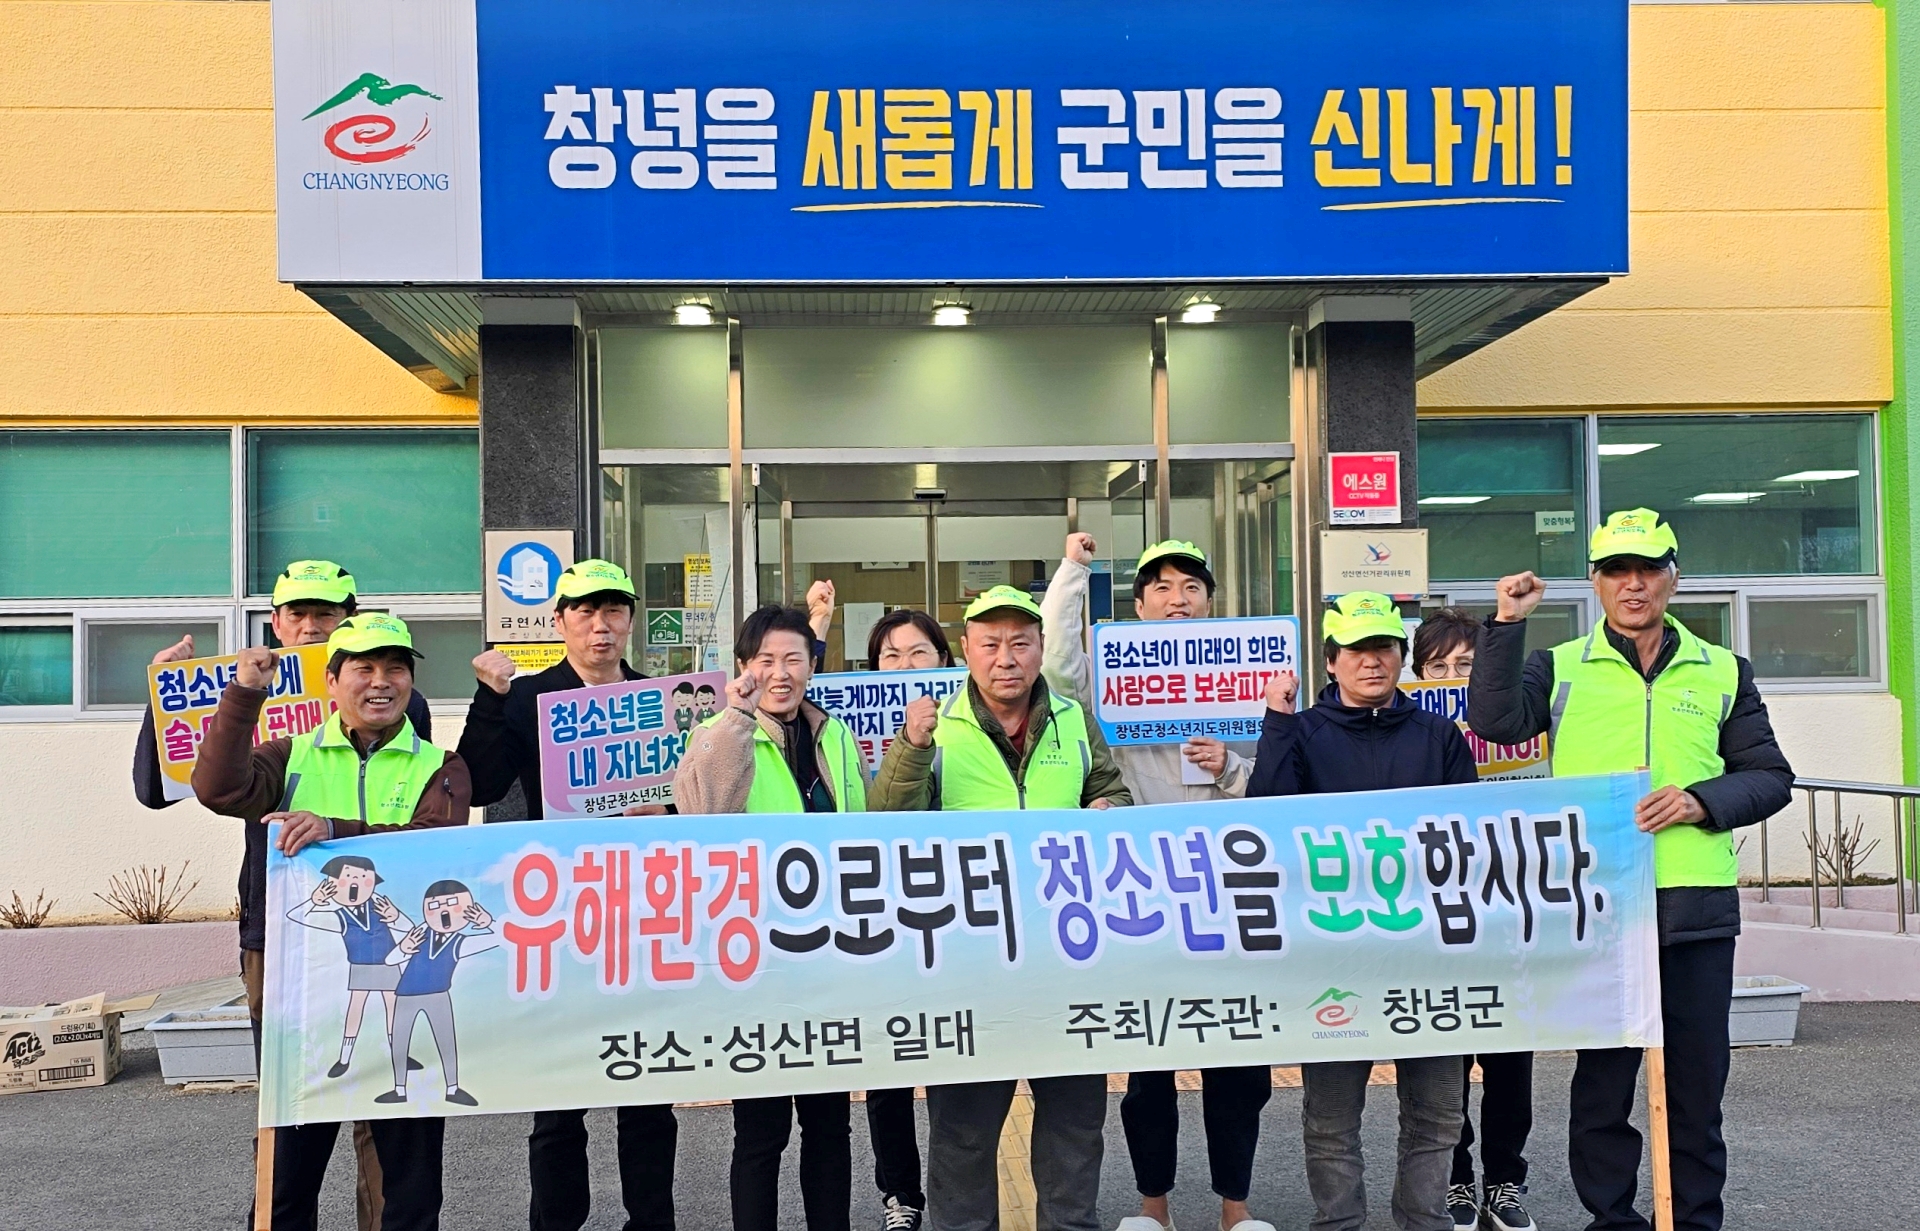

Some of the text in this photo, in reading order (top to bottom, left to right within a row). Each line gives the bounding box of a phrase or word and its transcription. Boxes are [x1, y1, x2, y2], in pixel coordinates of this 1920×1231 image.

[543, 84, 1574, 191] 창녕을 새롭게 군민을 신나게!
[302, 172, 450, 192] CHANGNYEONG
[1343, 473, 1387, 491] 에스원
[1333, 509, 1366, 518] SECOM
[1341, 569, 1411, 578] 성산면선거관리위원회
[1103, 635, 1292, 669] 청소년이 미래의 희망,
[157, 654, 303, 712] 청소게
[914, 679, 964, 701] 거리
[1102, 674, 1188, 707] 사랑으로
[550, 690, 664, 743] 청소년을
[568, 732, 688, 787] 내 자녀처
[584, 785, 673, 813] 창녕군청소년지도
[502, 812, 1605, 993] 유해환경으로부터 청소년을 보호합시다.
[1065, 985, 1504, 1049] 주최/주관: 창녕군
[886, 1008, 976, 1062] 일대
[1311, 1029, 1370, 1040] CHANGNYEONG
